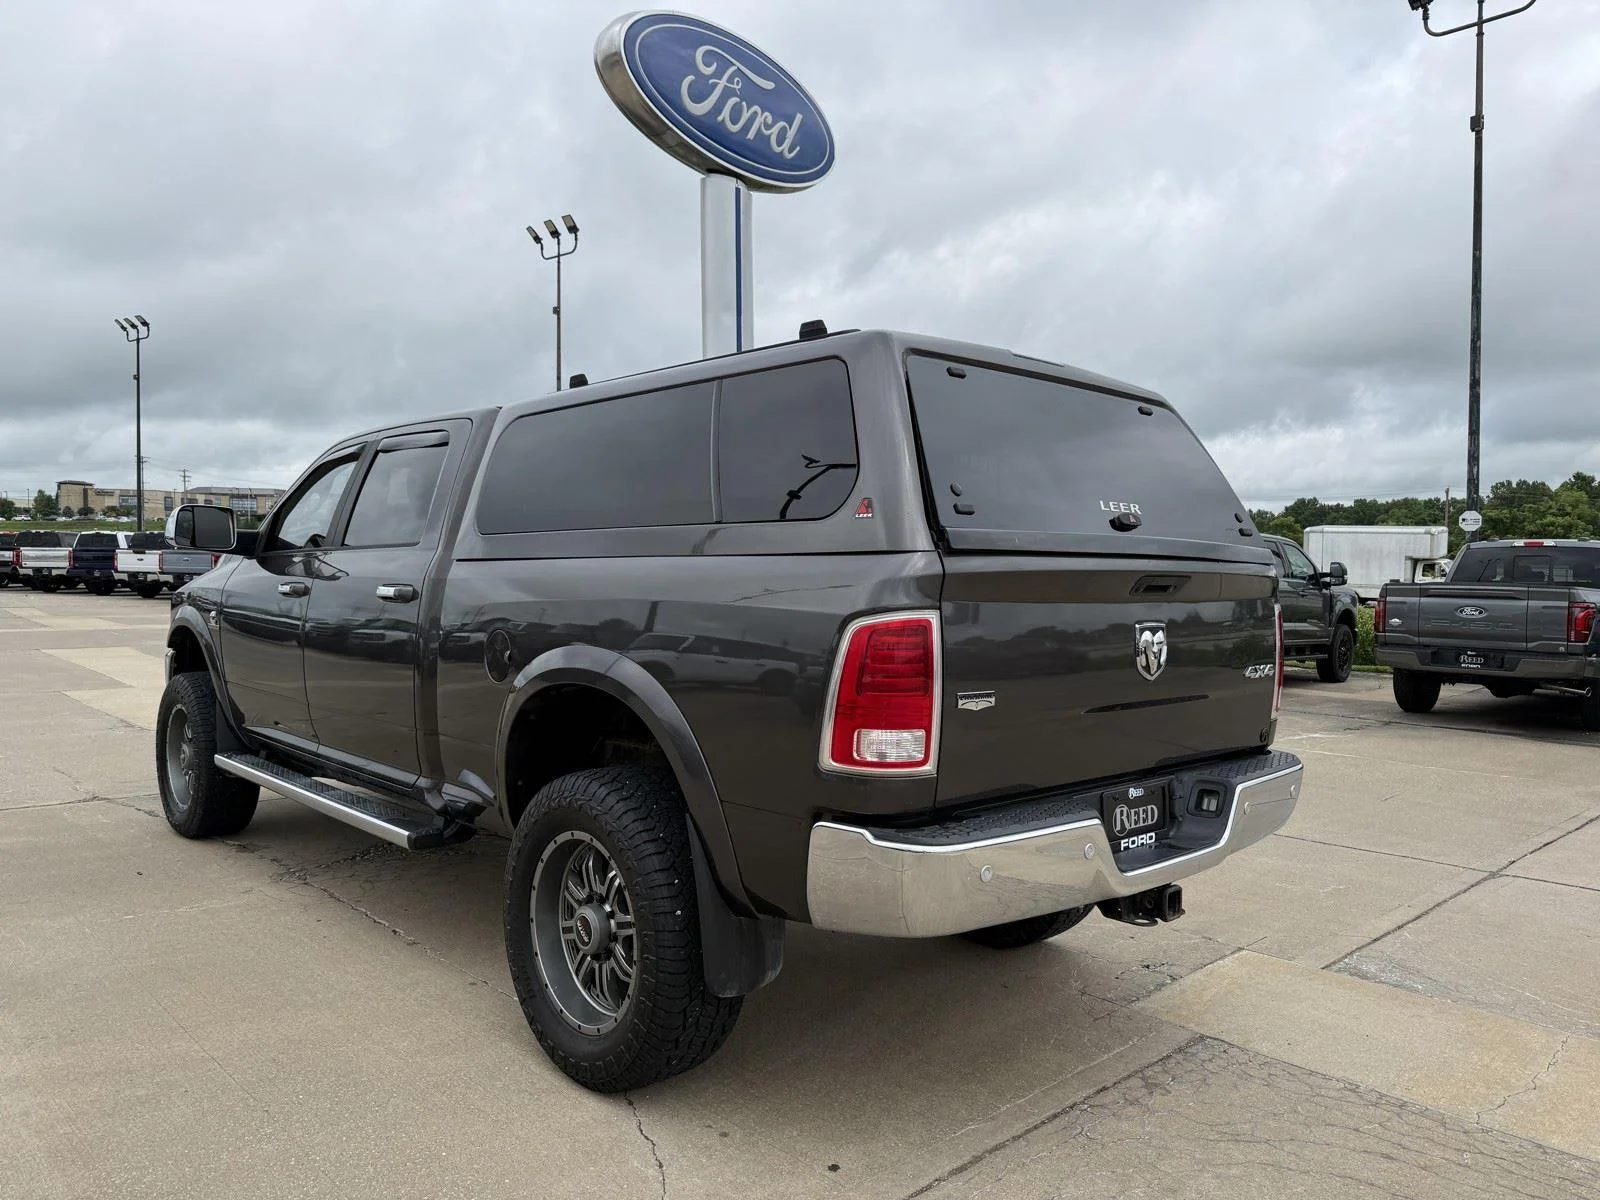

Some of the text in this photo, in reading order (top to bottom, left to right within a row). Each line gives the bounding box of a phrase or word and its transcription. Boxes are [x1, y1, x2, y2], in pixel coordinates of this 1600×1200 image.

[681, 45, 803, 160] Ford
[1099, 500, 1142, 515] LEER
[1120, 832, 1156, 851] FORD
